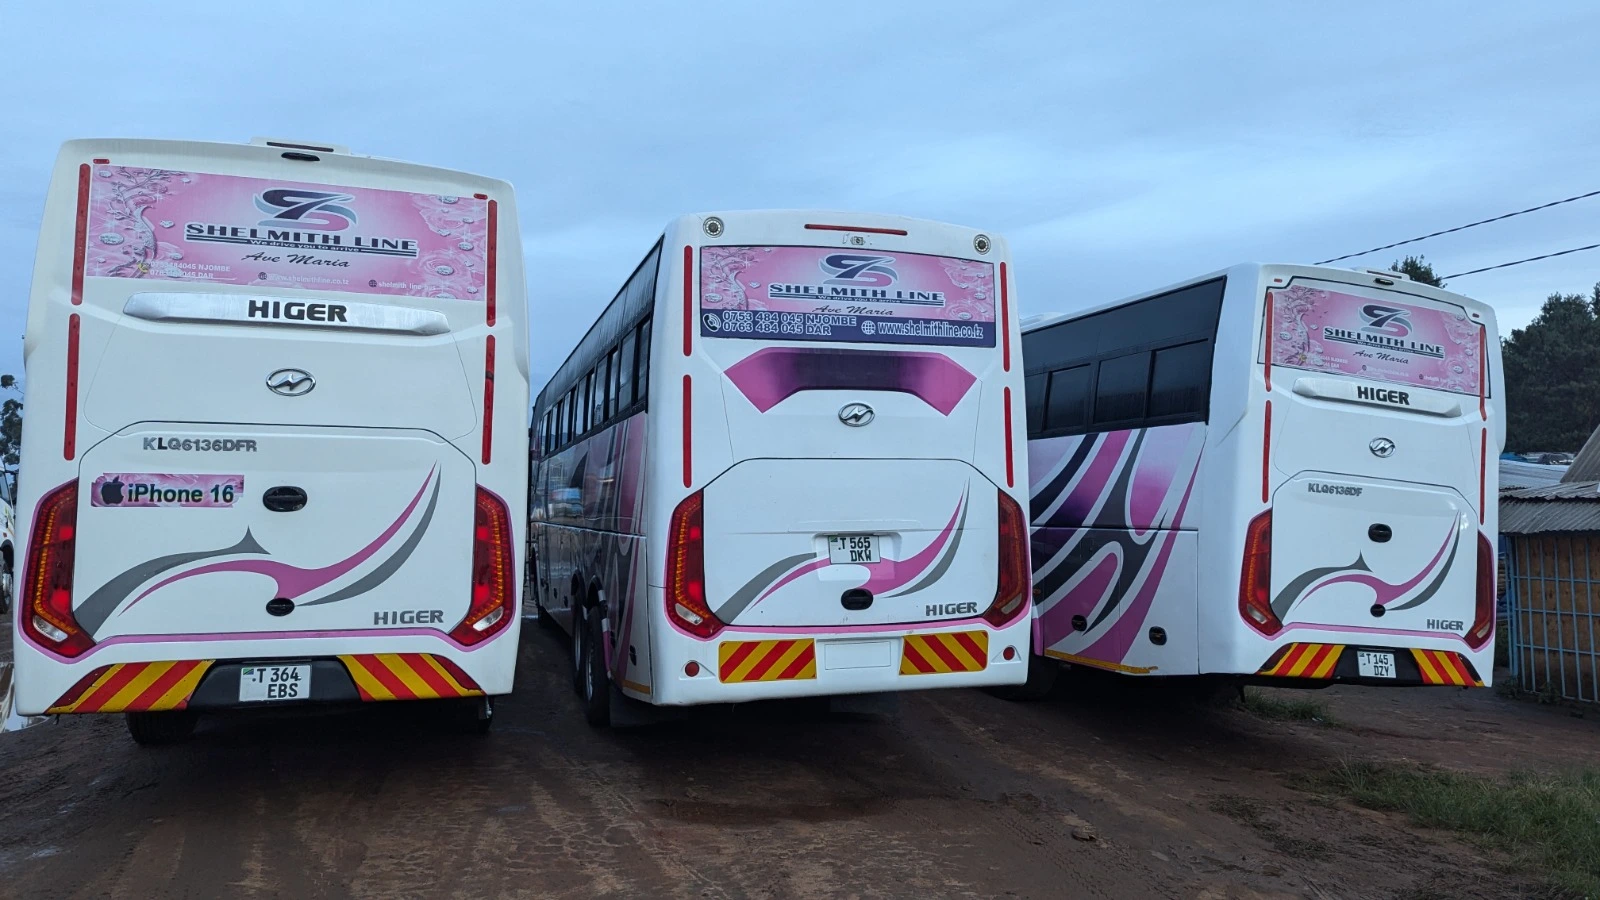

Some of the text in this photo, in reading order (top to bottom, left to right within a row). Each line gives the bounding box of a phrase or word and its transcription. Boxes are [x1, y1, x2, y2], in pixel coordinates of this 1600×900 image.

[186, 224, 418, 250] SHELMITH LINE
[241, 251, 351, 268] Ave Maria
[769, 284, 945, 301] SHELMITH LINE
[248, 300, 348, 322] HIGER
[812, 304, 894, 316] Ave Maria
[722, 310, 857, 326] 0753 484 045 NJOMBE
[722, 321, 832, 336] 0763 484 045 DAR
[877, 320, 984, 339] www.shelmithline.co.tz
[1324, 327, 1444, 354] SHELMITH LINE
[1352, 350, 1374, 358] Ave
[1376, 352, 1409, 364] Maria
[1357, 385, 1410, 406] HIGER
[143, 437, 258, 452] KLQ6136DFR
[127, 483, 234, 503] iPhone 16
[1308, 482, 1363, 496] KLQ6136DF
[840, 536, 871, 550] T 565
[850, 550, 872, 562] DKW
[925, 602, 978, 616] HIGER
[374, 610, 444, 626] HIGER
[1426, 618, 1464, 631] HIGER
[1366, 652, 1389, 665] T 145
[256, 667, 299, 683] T 364
[1374, 665, 1390, 676] DZY
[268, 683, 298, 698] EBS
